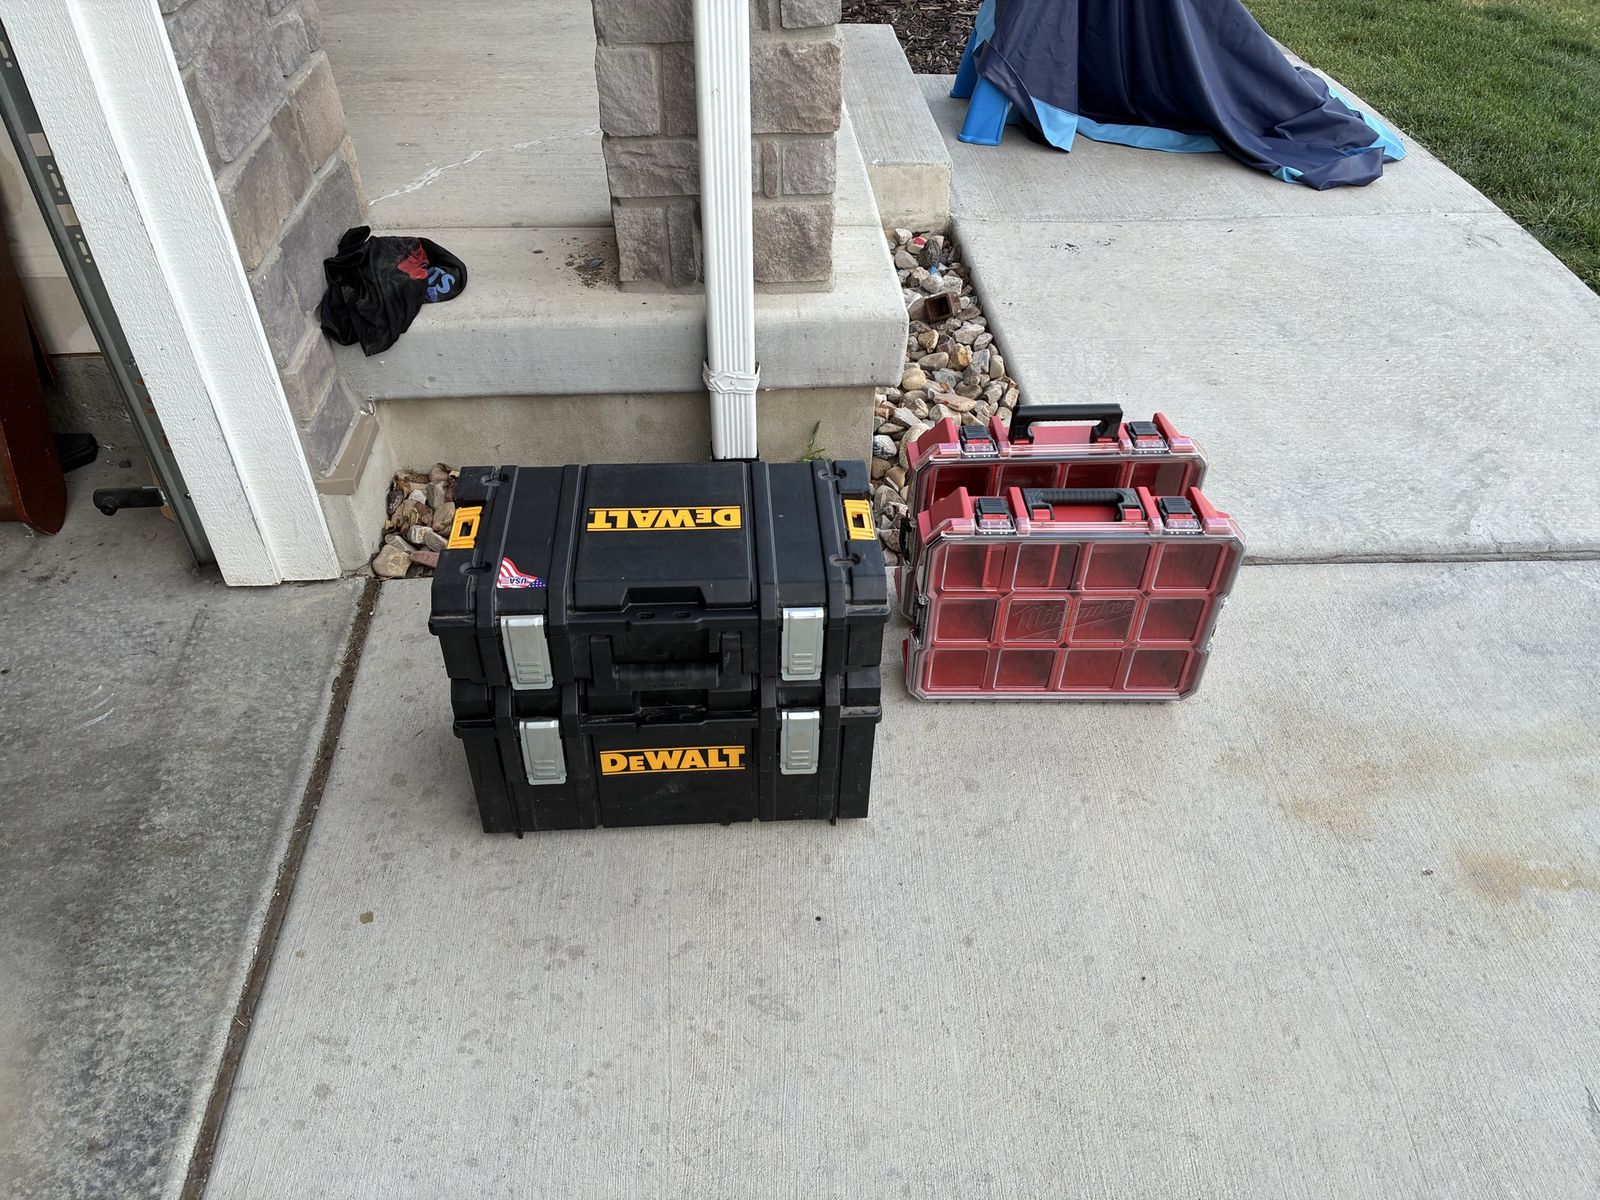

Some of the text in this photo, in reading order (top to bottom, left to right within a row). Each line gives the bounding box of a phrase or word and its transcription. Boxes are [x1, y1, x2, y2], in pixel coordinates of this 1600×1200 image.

[587, 507, 742, 530] DEWALT
[509, 577, 528, 585] USA
[600, 747, 745, 773] DEWALT
